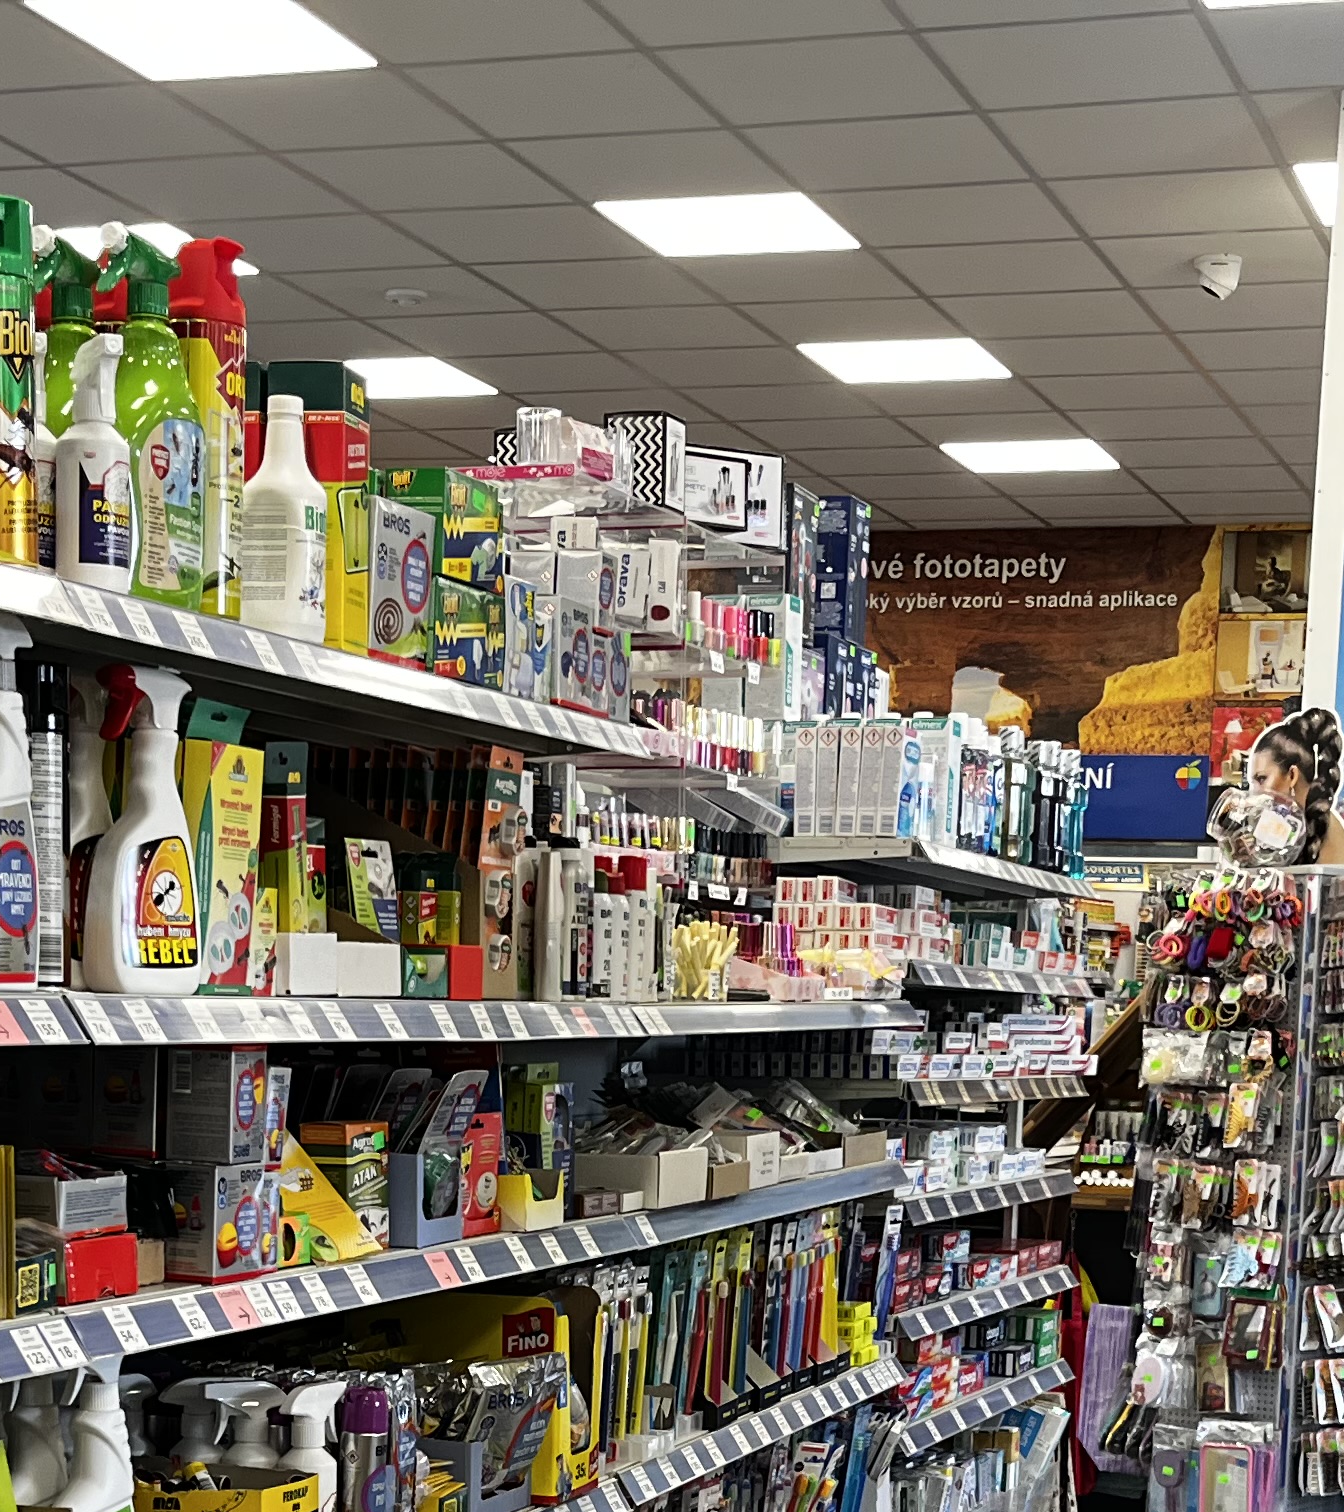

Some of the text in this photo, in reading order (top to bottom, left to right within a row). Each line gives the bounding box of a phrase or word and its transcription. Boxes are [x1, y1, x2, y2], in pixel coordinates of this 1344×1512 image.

[913, 554, 1067, 585] fototapety
[895, 591, 946, 610] výběr
[951, 590, 1004, 609] vzorů
[1024, 590, 1093, 608] snadná
[1099, 590, 1177, 609] aplikace
[1084, 763, 1111, 789] NÍ
[506, 1330, 550, 1355] FINO
